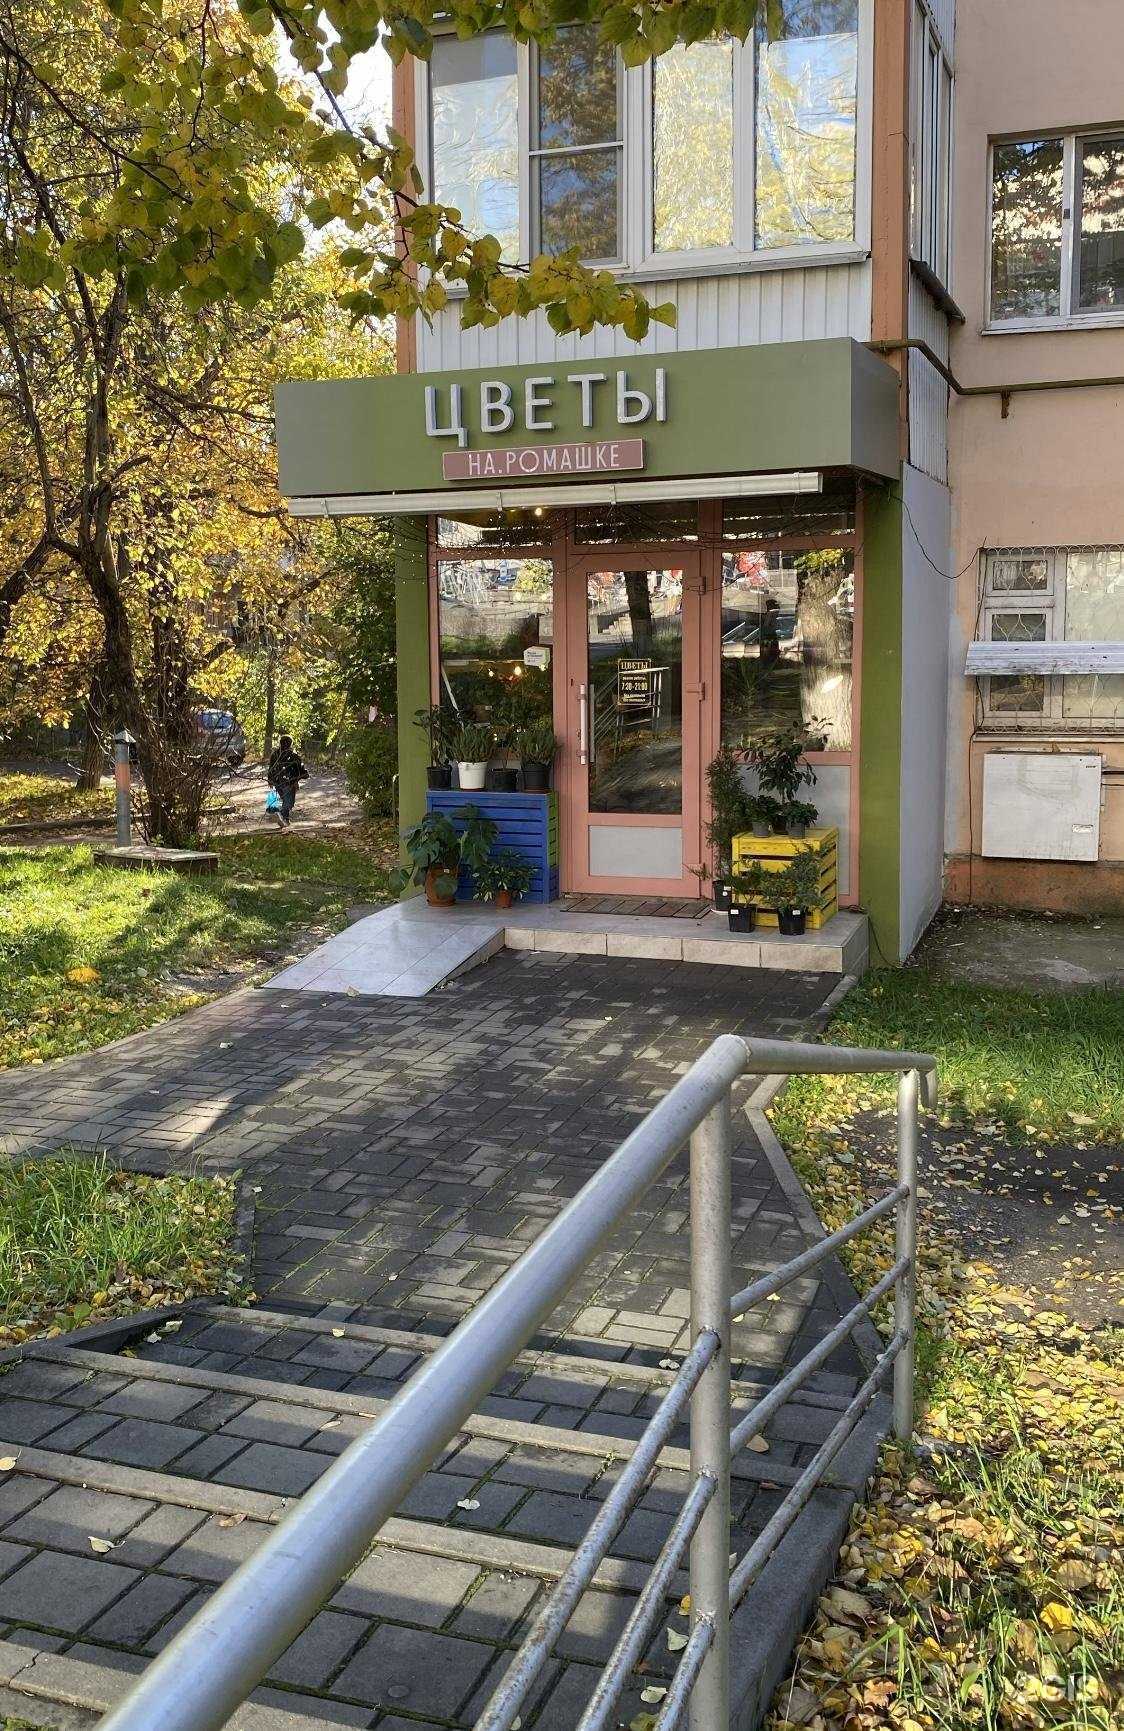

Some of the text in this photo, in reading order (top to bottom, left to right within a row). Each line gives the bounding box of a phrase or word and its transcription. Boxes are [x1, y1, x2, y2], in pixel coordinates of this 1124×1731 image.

[424, 368, 668, 448] ЦВЕТЫ
[468, 444, 620, 476] НА.РОМАШКЕ
[621, 661, 648, 671] ЦВЕТЫ
